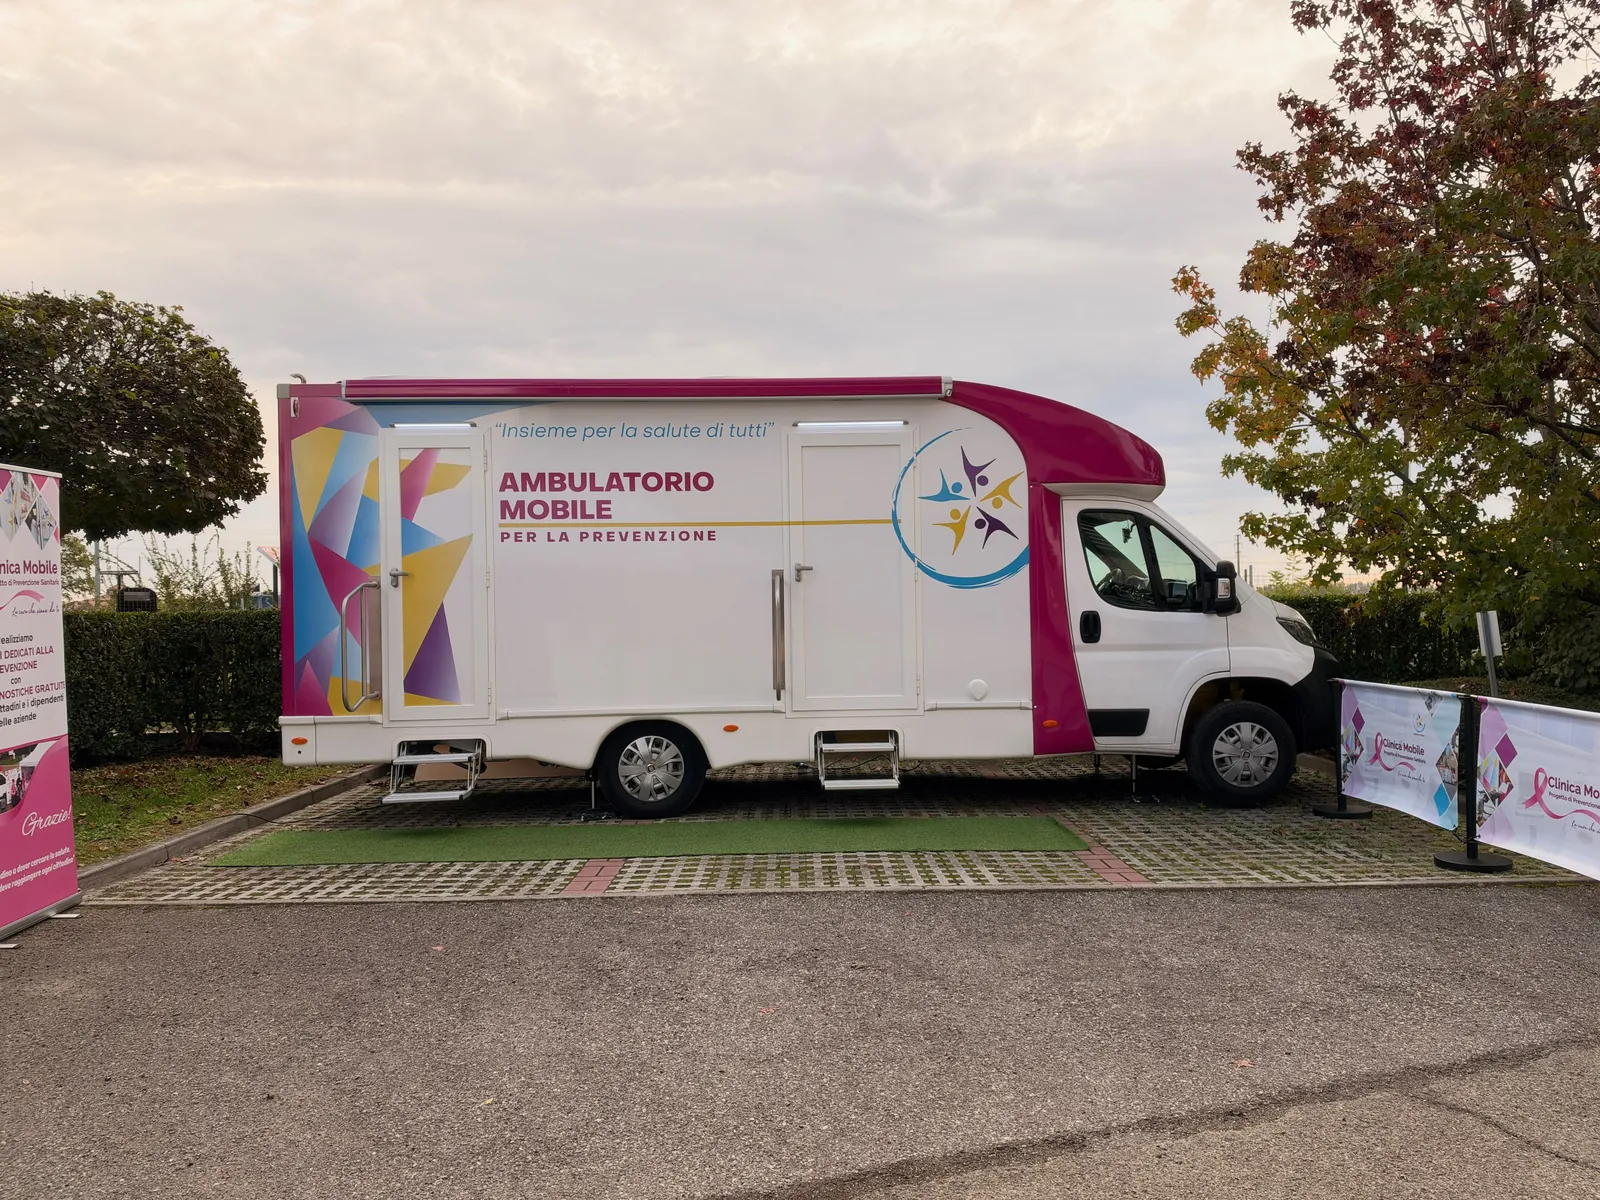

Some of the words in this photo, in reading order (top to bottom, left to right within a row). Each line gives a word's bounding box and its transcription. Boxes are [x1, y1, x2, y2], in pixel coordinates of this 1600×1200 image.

[582, 425, 616, 442] per
[620, 422, 638, 438] la
[642, 422, 701, 438] salute
[706, 422, 724, 438] di
[498, 472, 714, 492] AMBULATORIO
[500, 500, 612, 520] MOBILE
[500, 531, 538, 543] PER
[546, 531, 570, 542] LA
[580, 530, 717, 542] PREVENZIONE
[23, 560, 58, 574] Mobile
[0, 634, 34, 645] ealizziamo
[4, 647, 34, 659] DEDICATI
[36, 646, 54, 655] ALLA
[35, 681, 65, 694] GRATUITE
[27, 699, 29, 707] i
[31, 693, 64, 708] dipendenti
[13, 712, 37, 724] aziende
[1383, 738, 1402, 750] Clinica
[1403, 742, 1424, 756] Mobile
[1548, 776, 1582, 795] Clinica
[1584, 784, 1600, 800] Mo
[1549, 791, 1567, 801] Progetto
[22, 805, 72, 836] Grazie!
[17, 861, 30, 873] dover
[31, 854, 49, 867] cercare
[12, 870, 41, 887] raggiungere
[42, 864, 52, 876] ogni
